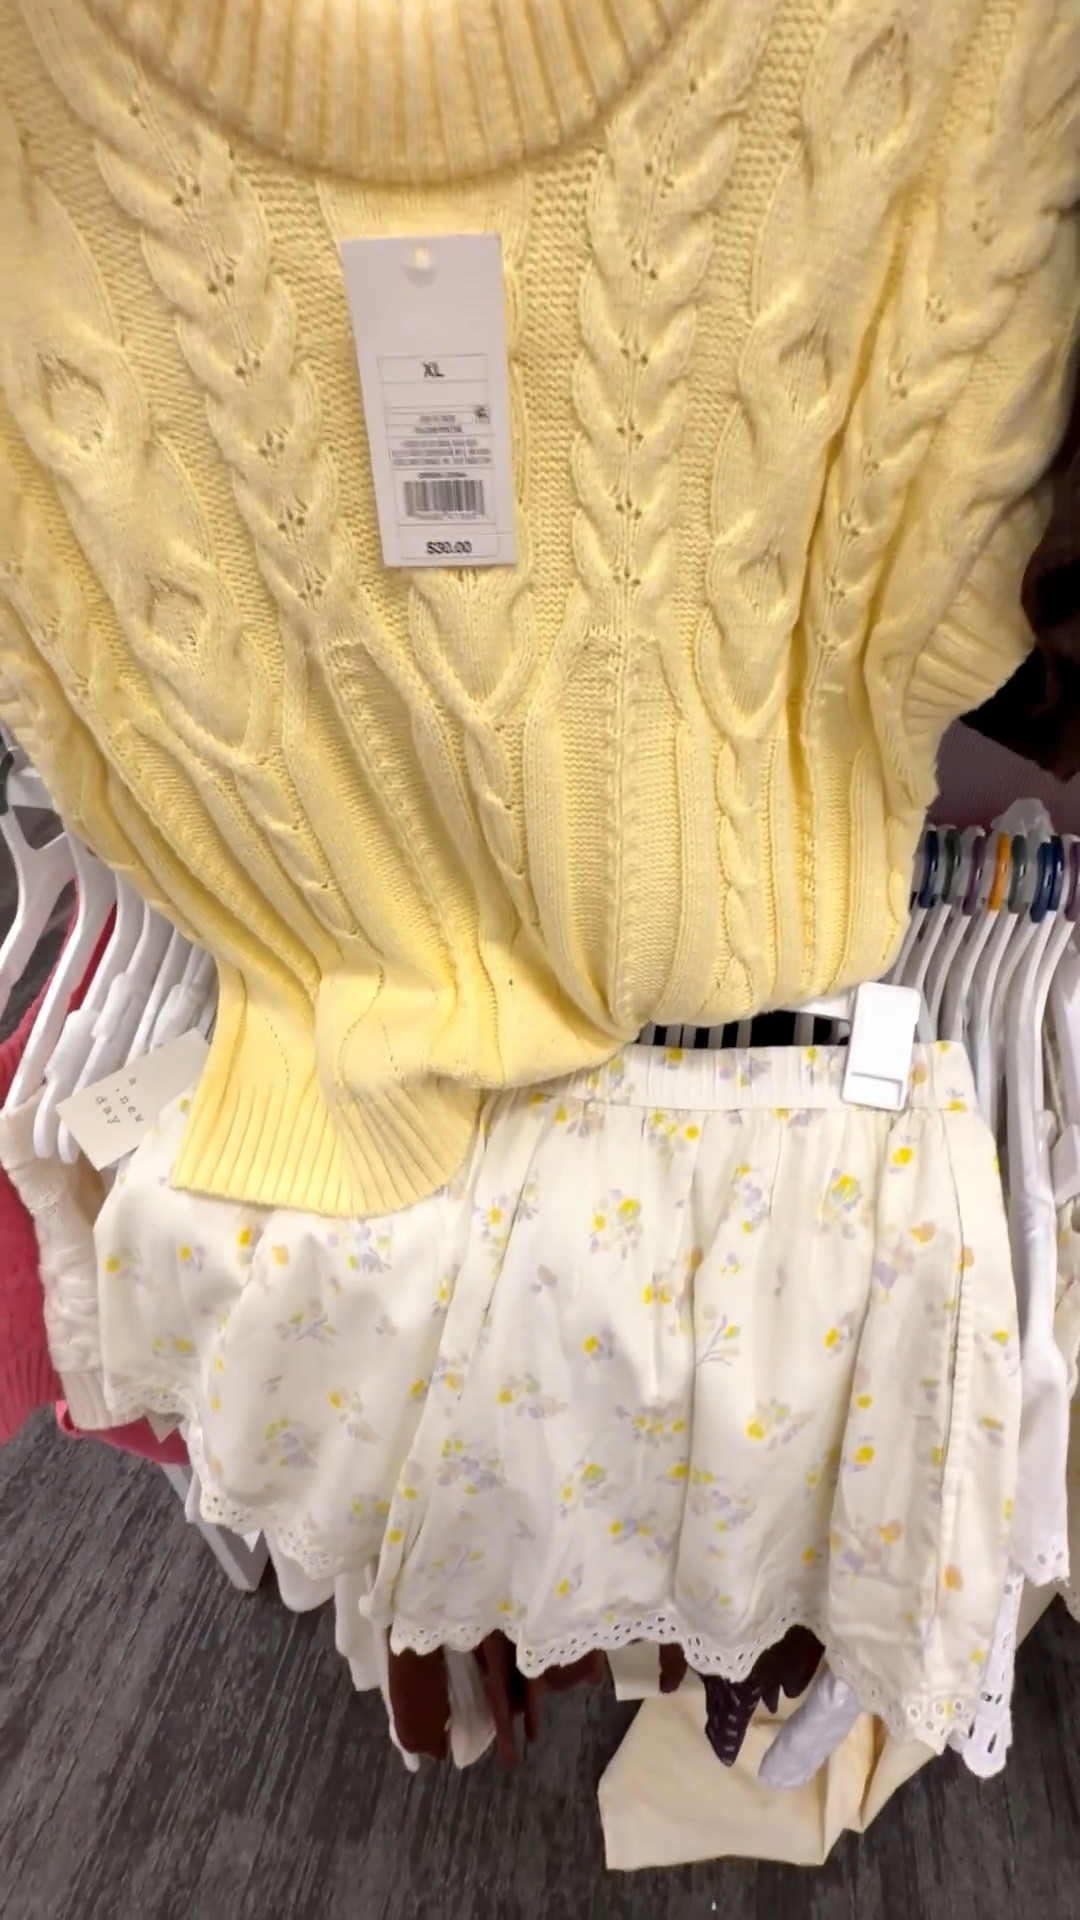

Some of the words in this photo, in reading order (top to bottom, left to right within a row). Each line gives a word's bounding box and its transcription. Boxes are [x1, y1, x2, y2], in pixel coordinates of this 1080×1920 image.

[422, 361, 445, 378] XL
[426, 541, 472, 554] $30.00
[95, 1095, 121, 1124] day
